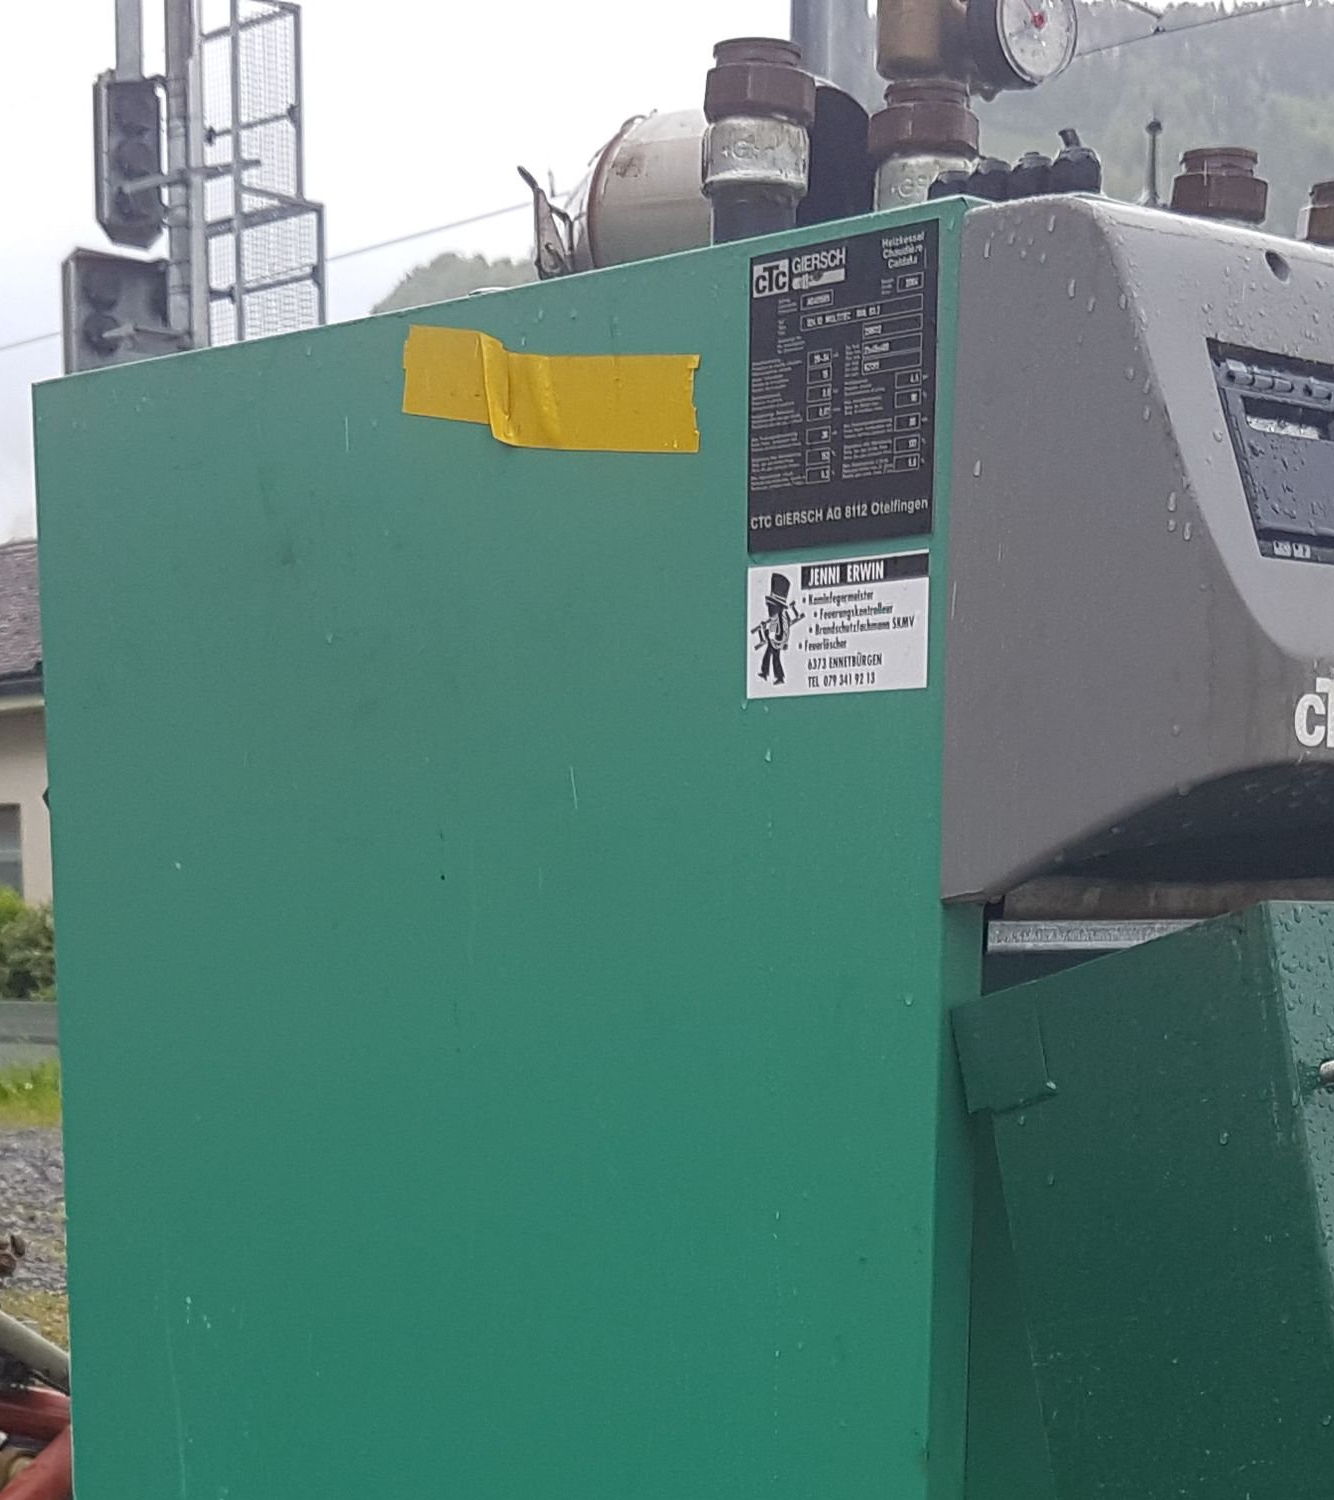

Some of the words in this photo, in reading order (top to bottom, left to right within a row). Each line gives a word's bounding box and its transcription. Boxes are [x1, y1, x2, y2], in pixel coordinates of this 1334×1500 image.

[881, 231, 926, 249] Heizkessel
[792, 247, 846, 274] GIERSCH
[754, 265, 788, 295] CTC
[750, 516, 772, 530] CTC
[775, 508, 823, 527] GIERSCH
[826, 506, 842, 521] AG
[845, 504, 868, 519] 8112
[871, 498, 929, 516] Otelfingen
[808, 565, 841, 587] JENNI
[847, 560, 885, 583] ERWIN
[808, 590, 874, 606] Kaminfegermeister
[819, 602, 893, 621] Feuerungskontrolleur
[814, 620, 890, 636] Brandschutzfachmann
[892, 615, 915, 629] SKMV
[804, 638, 847, 652] Feuerlöscher
[808, 656, 827, 670] 6373
[829, 652, 883, 668] ENNETBÜRGEN
[808, 676, 820, 688] TEL
[823, 674, 837, 687] 079
[839, 673, 852, 686] 341
[854, 672, 864, 685] 92
[866, 671, 876, 685] 13
